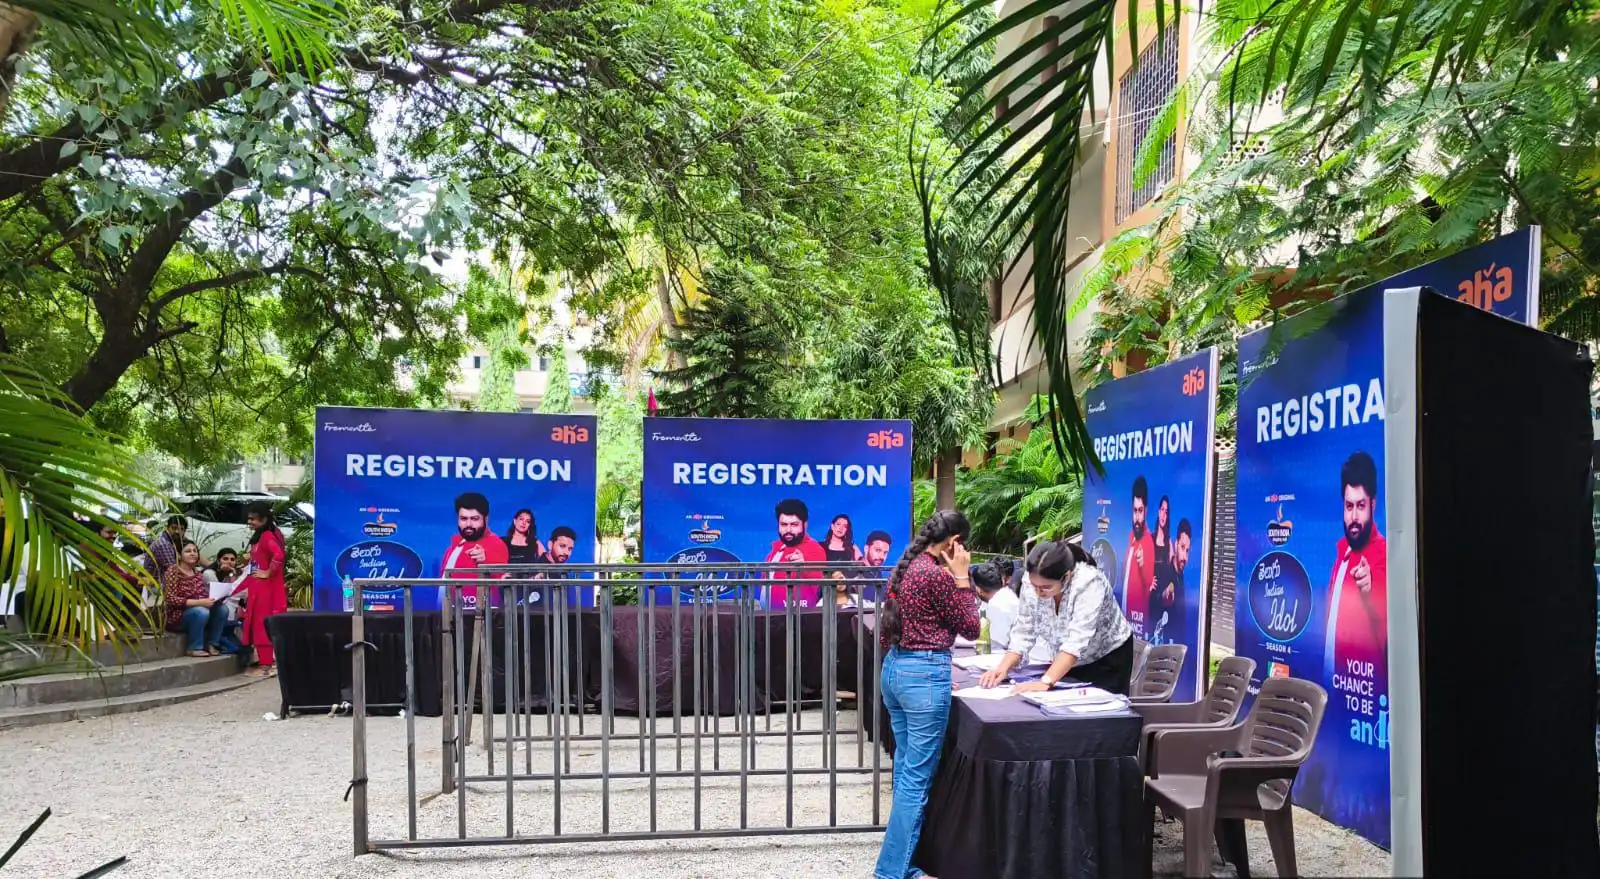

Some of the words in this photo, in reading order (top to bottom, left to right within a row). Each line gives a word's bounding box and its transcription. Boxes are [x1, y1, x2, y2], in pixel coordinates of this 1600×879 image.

[1457, 262, 1513, 312] aha
[1182, 365, 1205, 396] aha
[324, 422, 377, 433] Fremantle
[551, 424, 589, 444] aha
[652, 432, 702, 442] Fremantle
[867, 429, 904, 449] aha
[1094, 420, 1193, 462] REGISTRATION
[346, 453, 572, 482] REGISTRATION
[673, 462, 888, 487] REGISTRATION
[350, 545, 382, 558] తెలుగు
[359, 558, 387, 569] Indian
[1258, 558, 1281, 581] తెలుగు
[1263, 581, 1285, 598] Indian
[1267, 598, 1298, 633] Idol
[1265, 641, 1287, 653] SEASON
[1287, 646, 1292, 655] 4
[1346, 658, 1374, 678] YOUR
[1332, 674, 1374, 697] CHANCE
[1345, 694, 1360, 712] TO
[1361, 699, 1374, 716] BE
[1350, 718, 1374, 746] an
